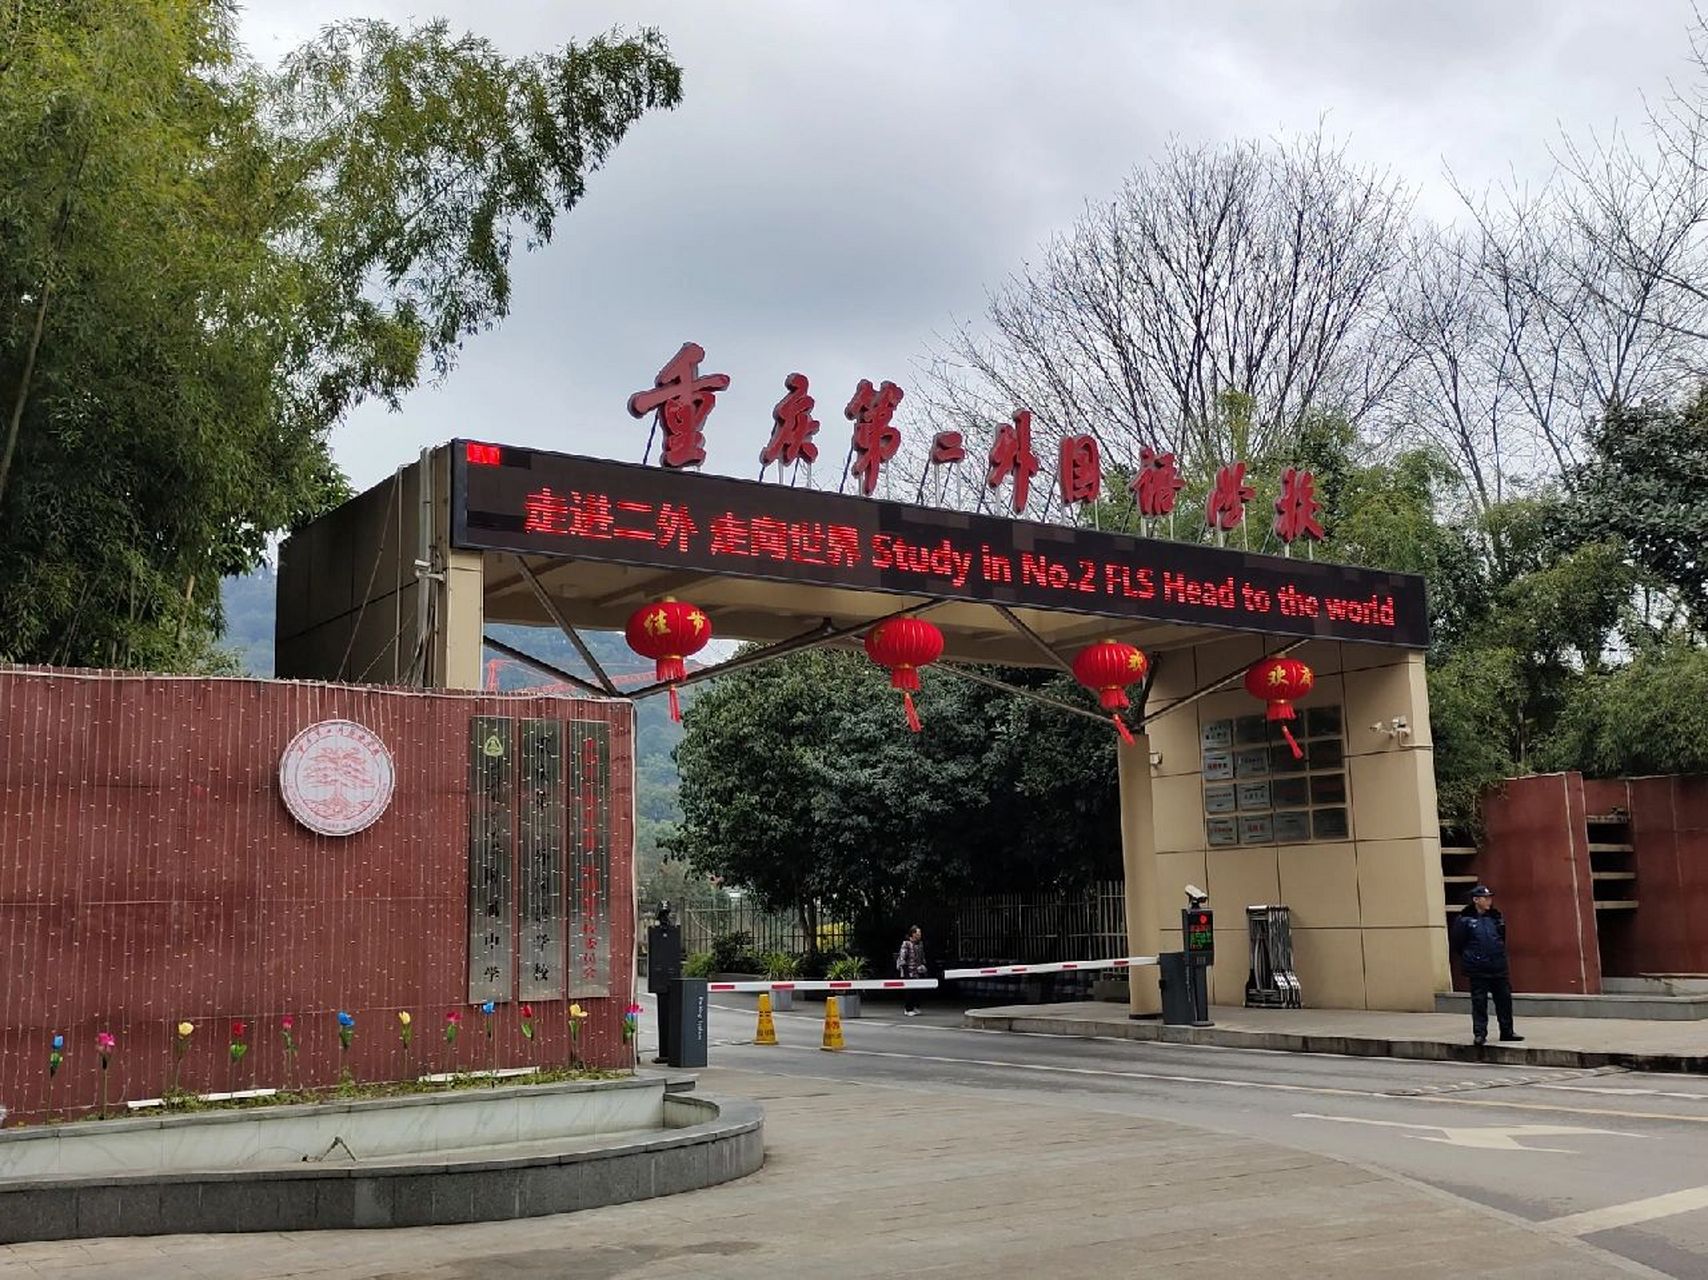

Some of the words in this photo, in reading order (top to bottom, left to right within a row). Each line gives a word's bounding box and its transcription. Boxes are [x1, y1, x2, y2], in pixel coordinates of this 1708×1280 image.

[628, 342, 1324, 543] 重庆第二外国语学校
[524, 488, 698, 552] 走进二外
[710, 511, 861, 567] 走向世界
[872, 534, 971, 588] Study
[981, 545, 1011, 582] in
[1022, 553, 1096, 592] No.2
[1106, 564, 1157, 599] FLS
[1163, 571, 1235, 609] Head
[1242, 583, 1271, 613] to
[1278, 585, 1320, 618] the
[1326, 594, 1396, 626] world
